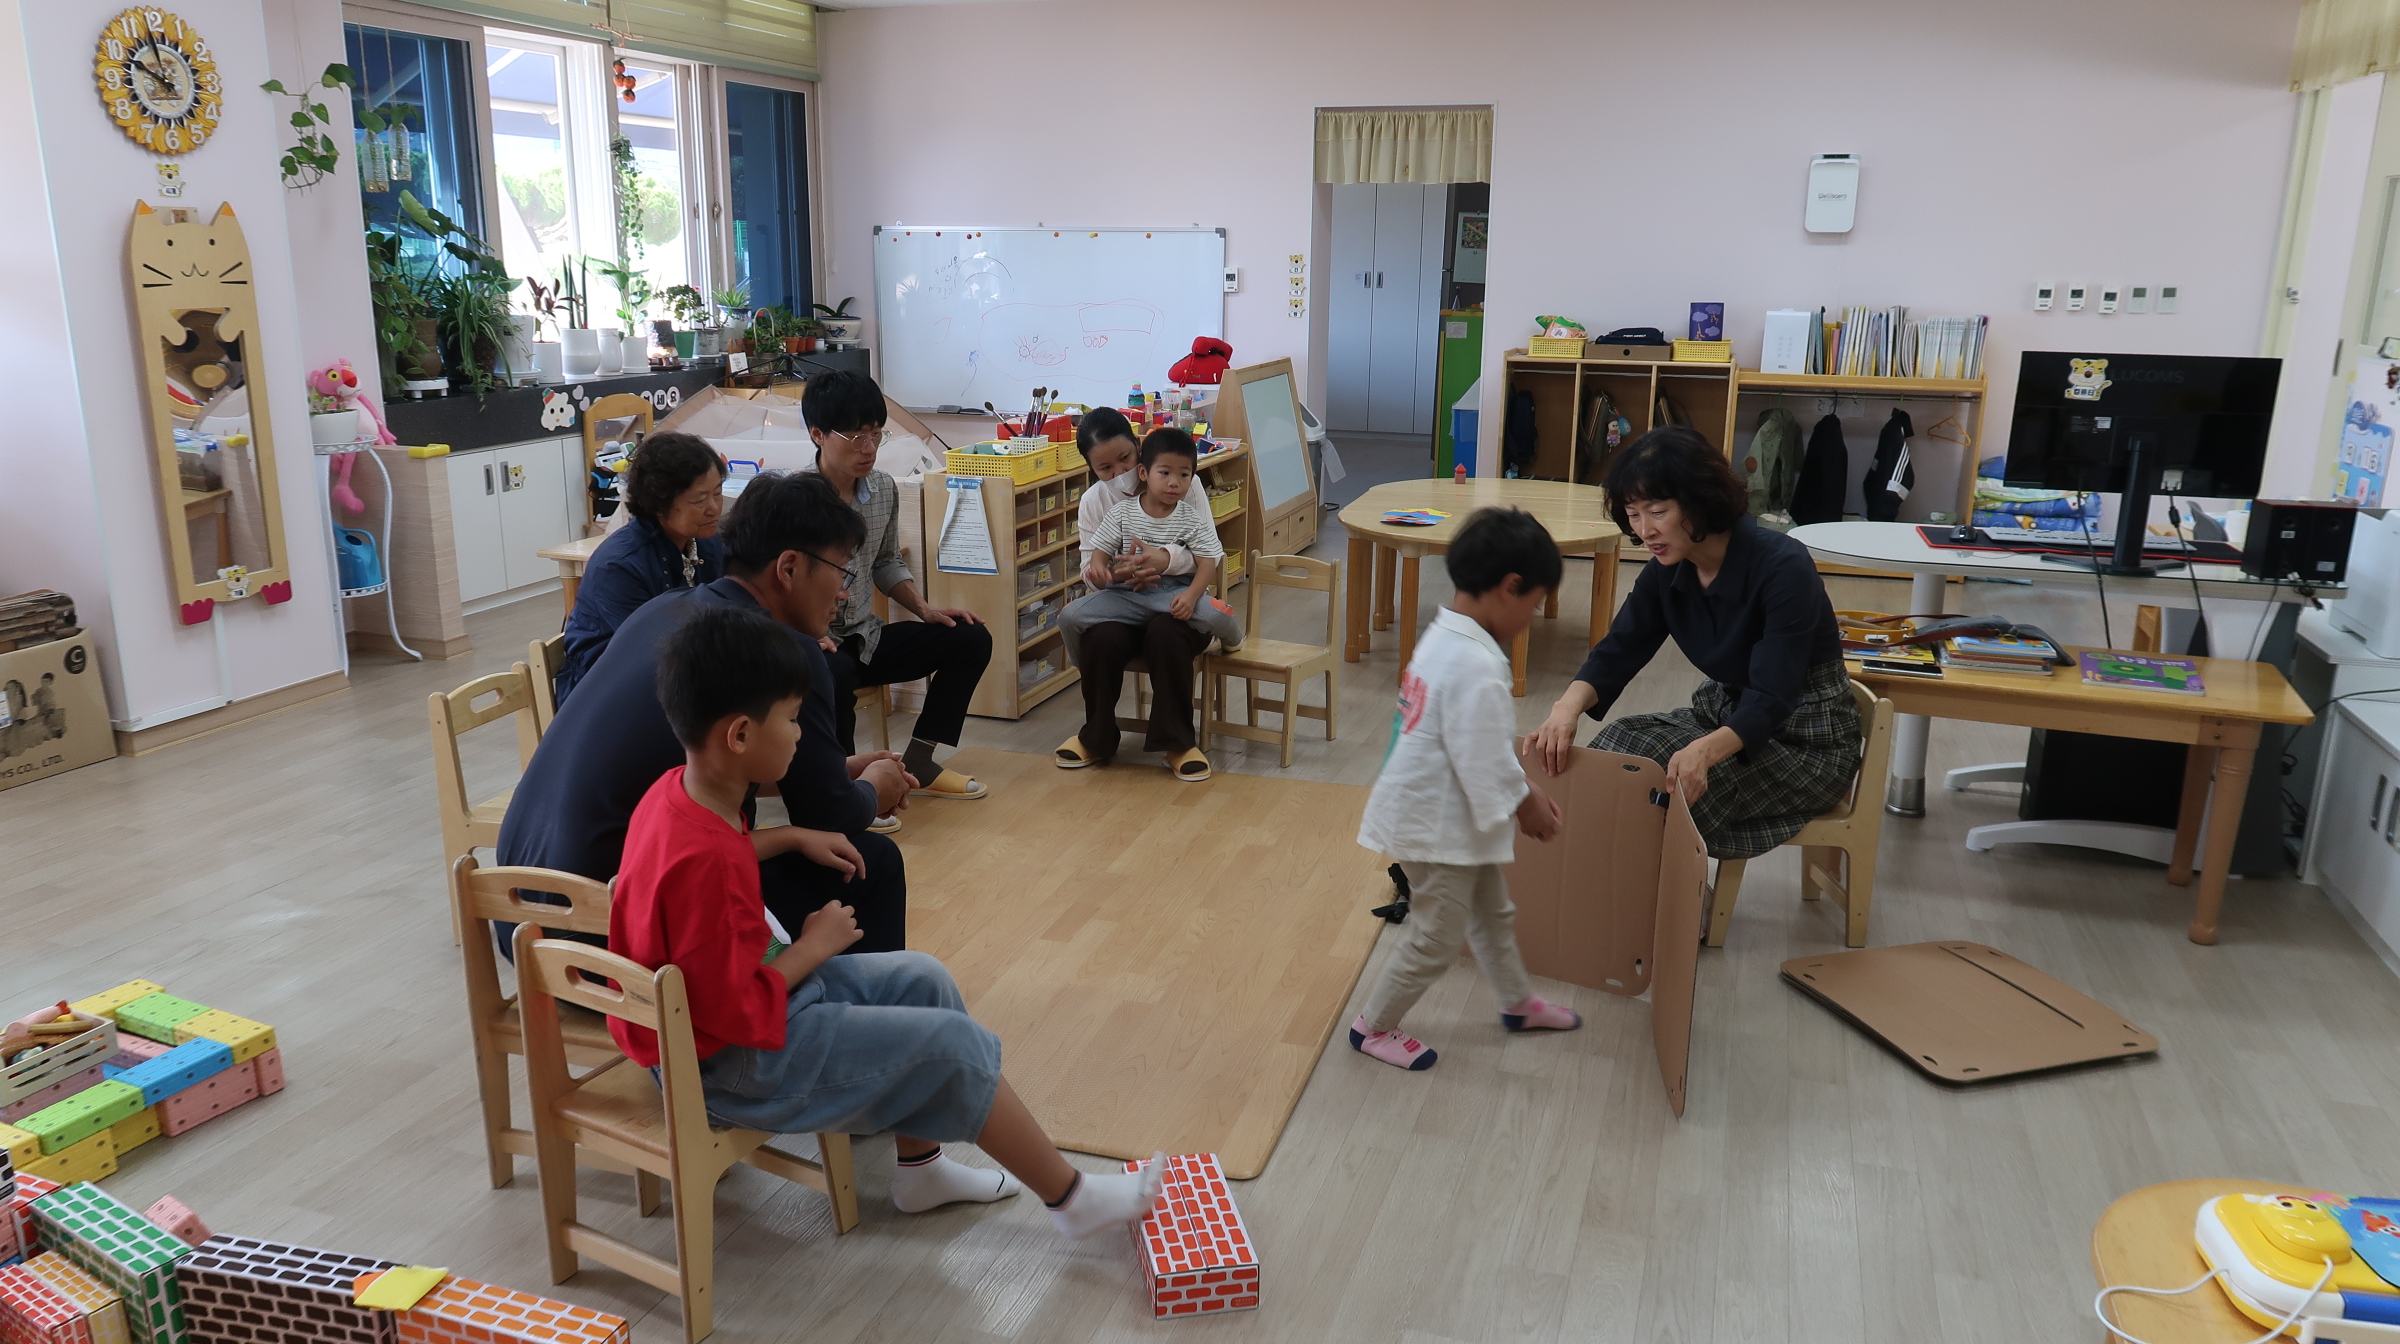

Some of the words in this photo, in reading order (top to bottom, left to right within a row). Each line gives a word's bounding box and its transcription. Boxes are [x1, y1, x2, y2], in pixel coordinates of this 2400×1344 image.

[121, 17, 138, 38] 11
[144, 11, 164, 32] 12
[174, 19, 184, 39] 1
[105, 39, 124, 61] 10
[194, 41, 210, 62] 2
[104, 69, 121, 91] 9
[206, 73, 221, 94] 3
[115, 98, 132, 120] 8
[205, 102, 220, 121] 4
[140, 123, 155, 144] 7
[165, 130, 181, 150] 6
[190, 124, 205, 144] 5
[2110, 369, 2184, 383] LUCOMS
